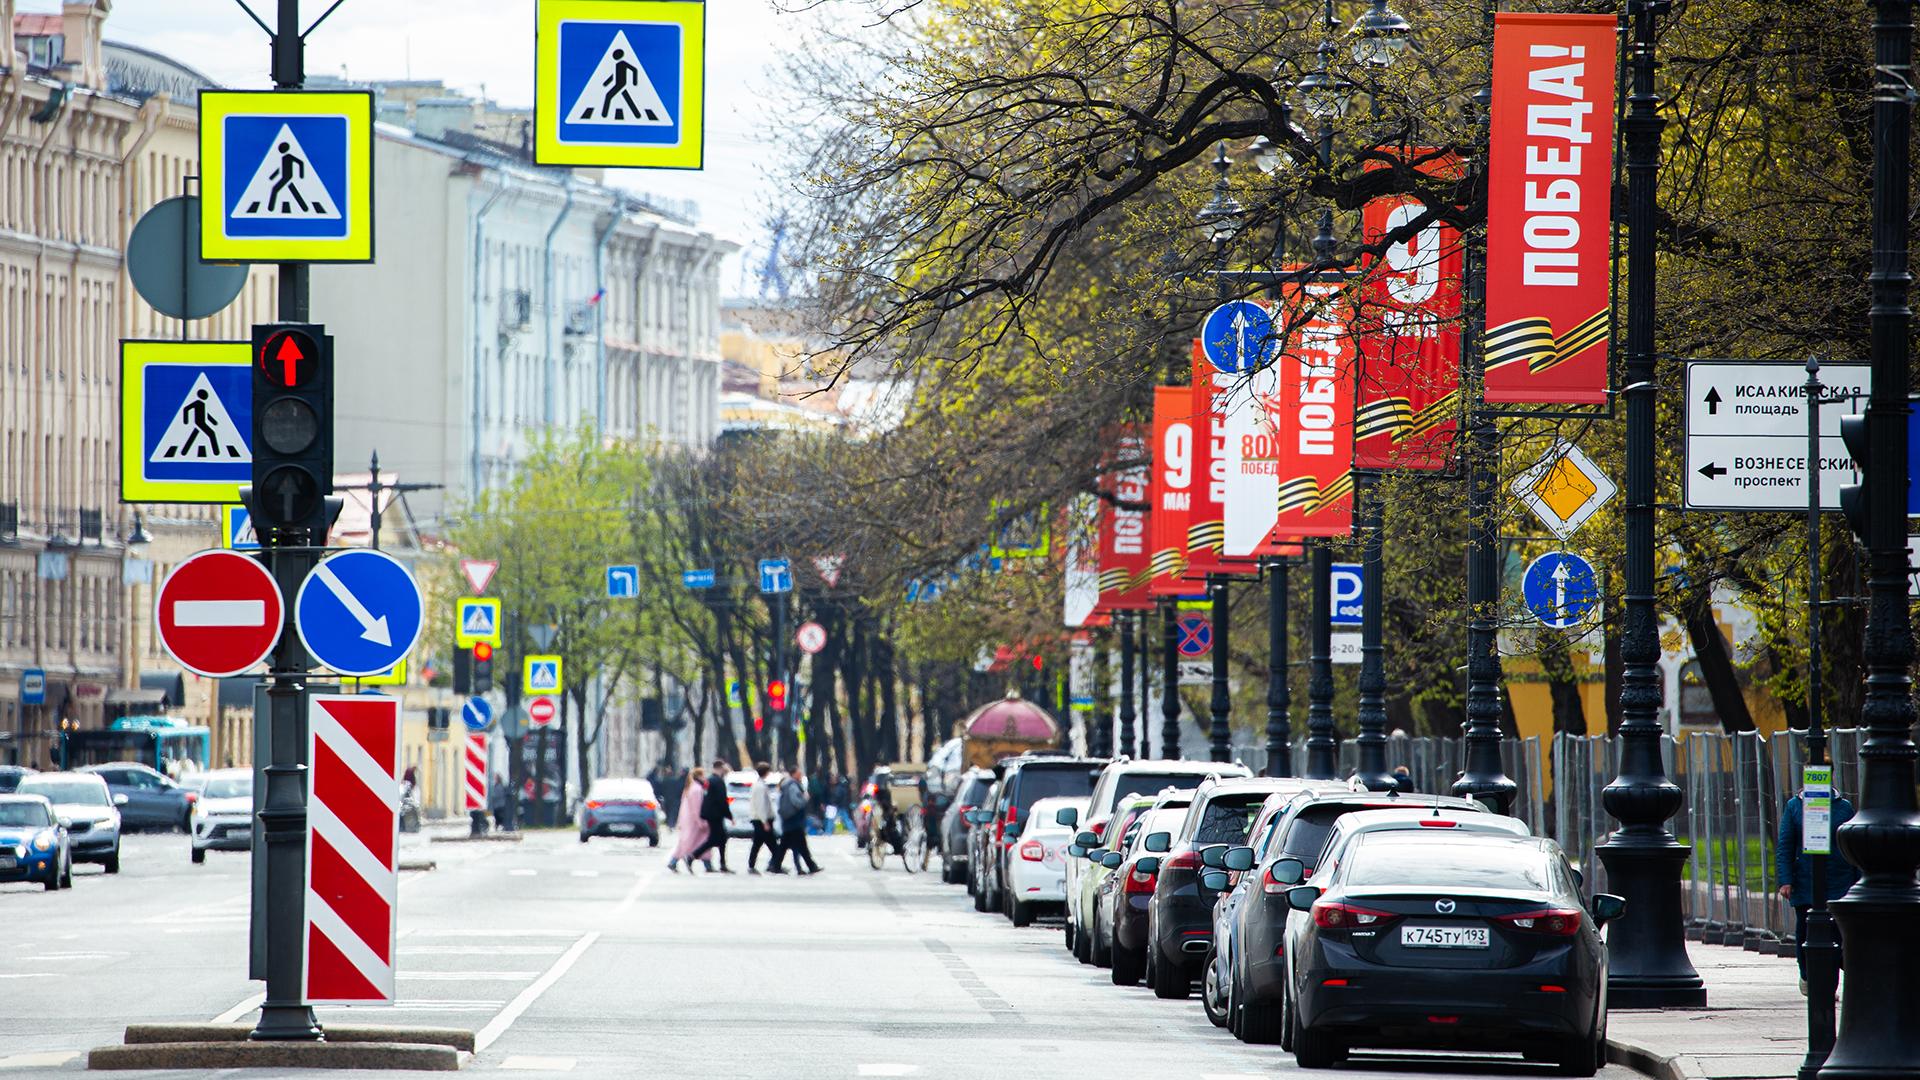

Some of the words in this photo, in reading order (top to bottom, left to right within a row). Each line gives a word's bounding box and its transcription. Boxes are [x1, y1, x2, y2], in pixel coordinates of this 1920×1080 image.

[1523, 44, 1593, 286] ПОБЕДА!
[1386, 204, 1440, 304] 9
[1735, 385, 1861, 398] ИСААКИЕСКАЯ
[1735, 405, 1799, 416] площадь
[1164, 423, 1193, 489] 9
[1734, 457, 1856, 470] ВОЗНЕСЕСКИ
[1734, 476, 1801, 489] проспект
[1331, 571, 1363, 617] P
[1807, 773, 1828, 781] 7807
[1464, 929, 1485, 941] 193
